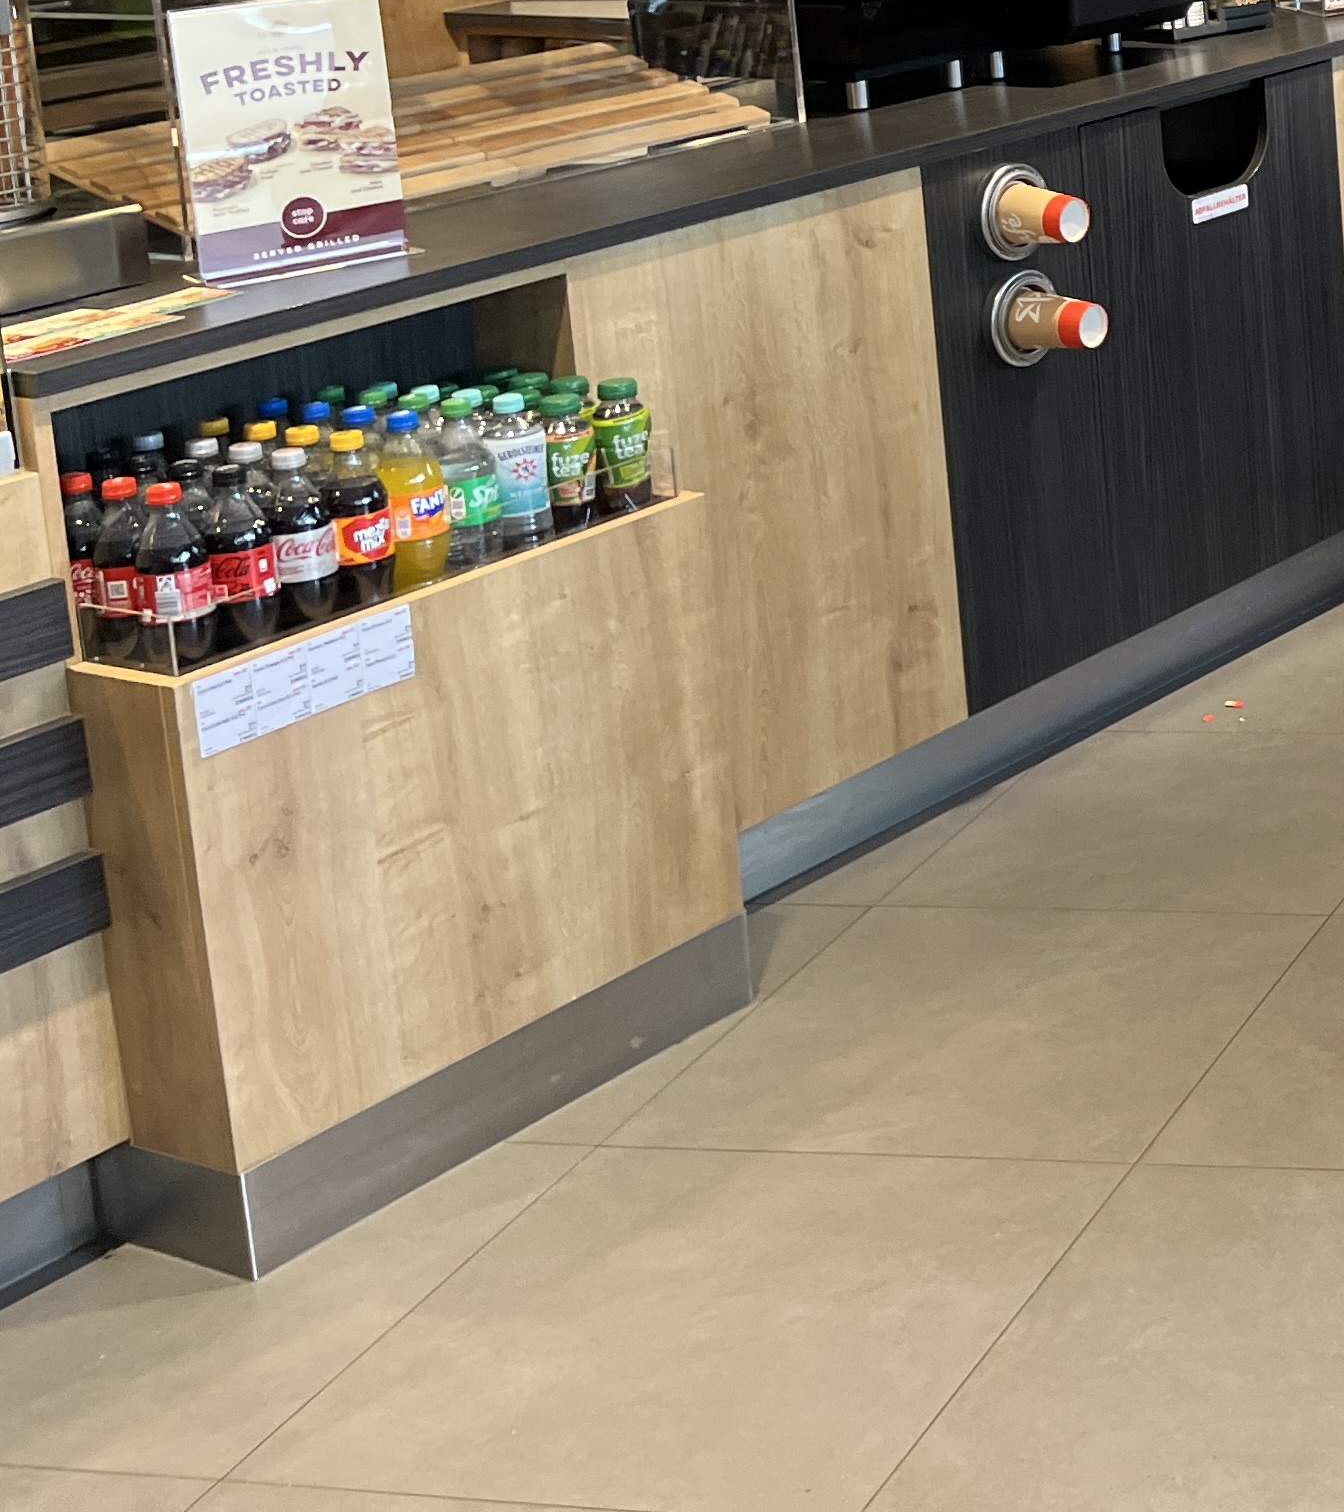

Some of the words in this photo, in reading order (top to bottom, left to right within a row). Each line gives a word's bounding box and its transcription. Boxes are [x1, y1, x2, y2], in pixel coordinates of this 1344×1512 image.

[200, 51, 370, 95] FRESHLY
[234, 79, 342, 106] TOASTED
[253, 244, 302, 260] SERVED
[307, 234, 360, 250] GRILLED
[613, 431, 648, 448] fuze
[551, 452, 590, 469] fuze
[617, 444, 643, 459] tea
[552, 464, 582, 476] tea
[277, 539, 311, 561] Coca
